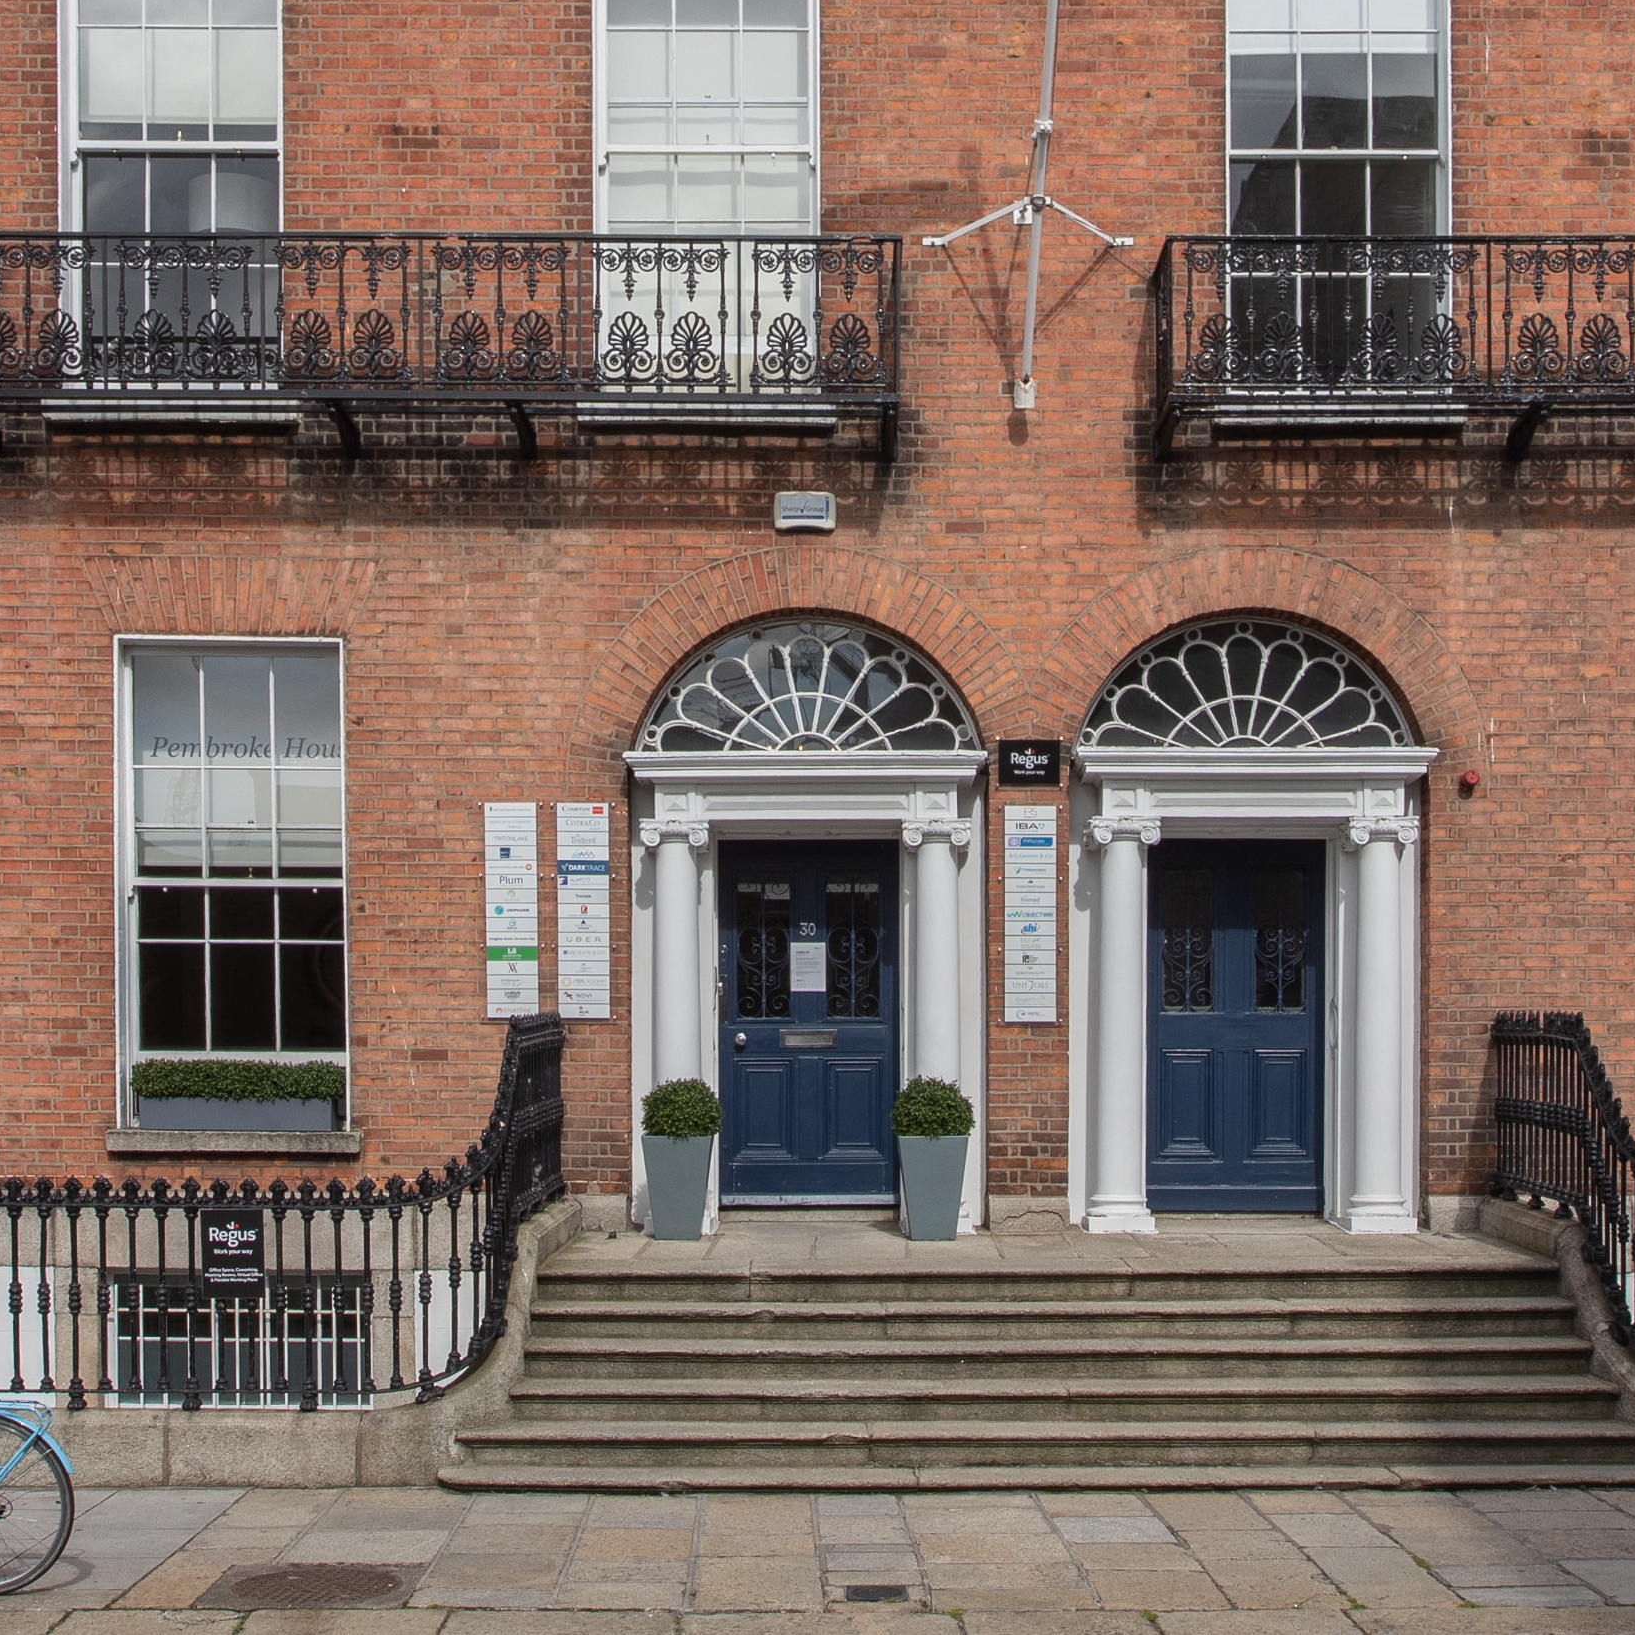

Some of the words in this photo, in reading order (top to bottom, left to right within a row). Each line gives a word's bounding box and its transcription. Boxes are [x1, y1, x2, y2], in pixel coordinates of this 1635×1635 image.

[150, 736, 272, 759] Pembroke
[1010, 752, 1048, 769] Regus
[1015, 822, 1039, 830] IBA
[570, 836, 597, 844] Trident
[499, 876, 523, 884] Plum
[799, 922, 816, 936] 30
[1022, 923, 1038, 933] shi
[209, 1227, 256, 1248] Regus
